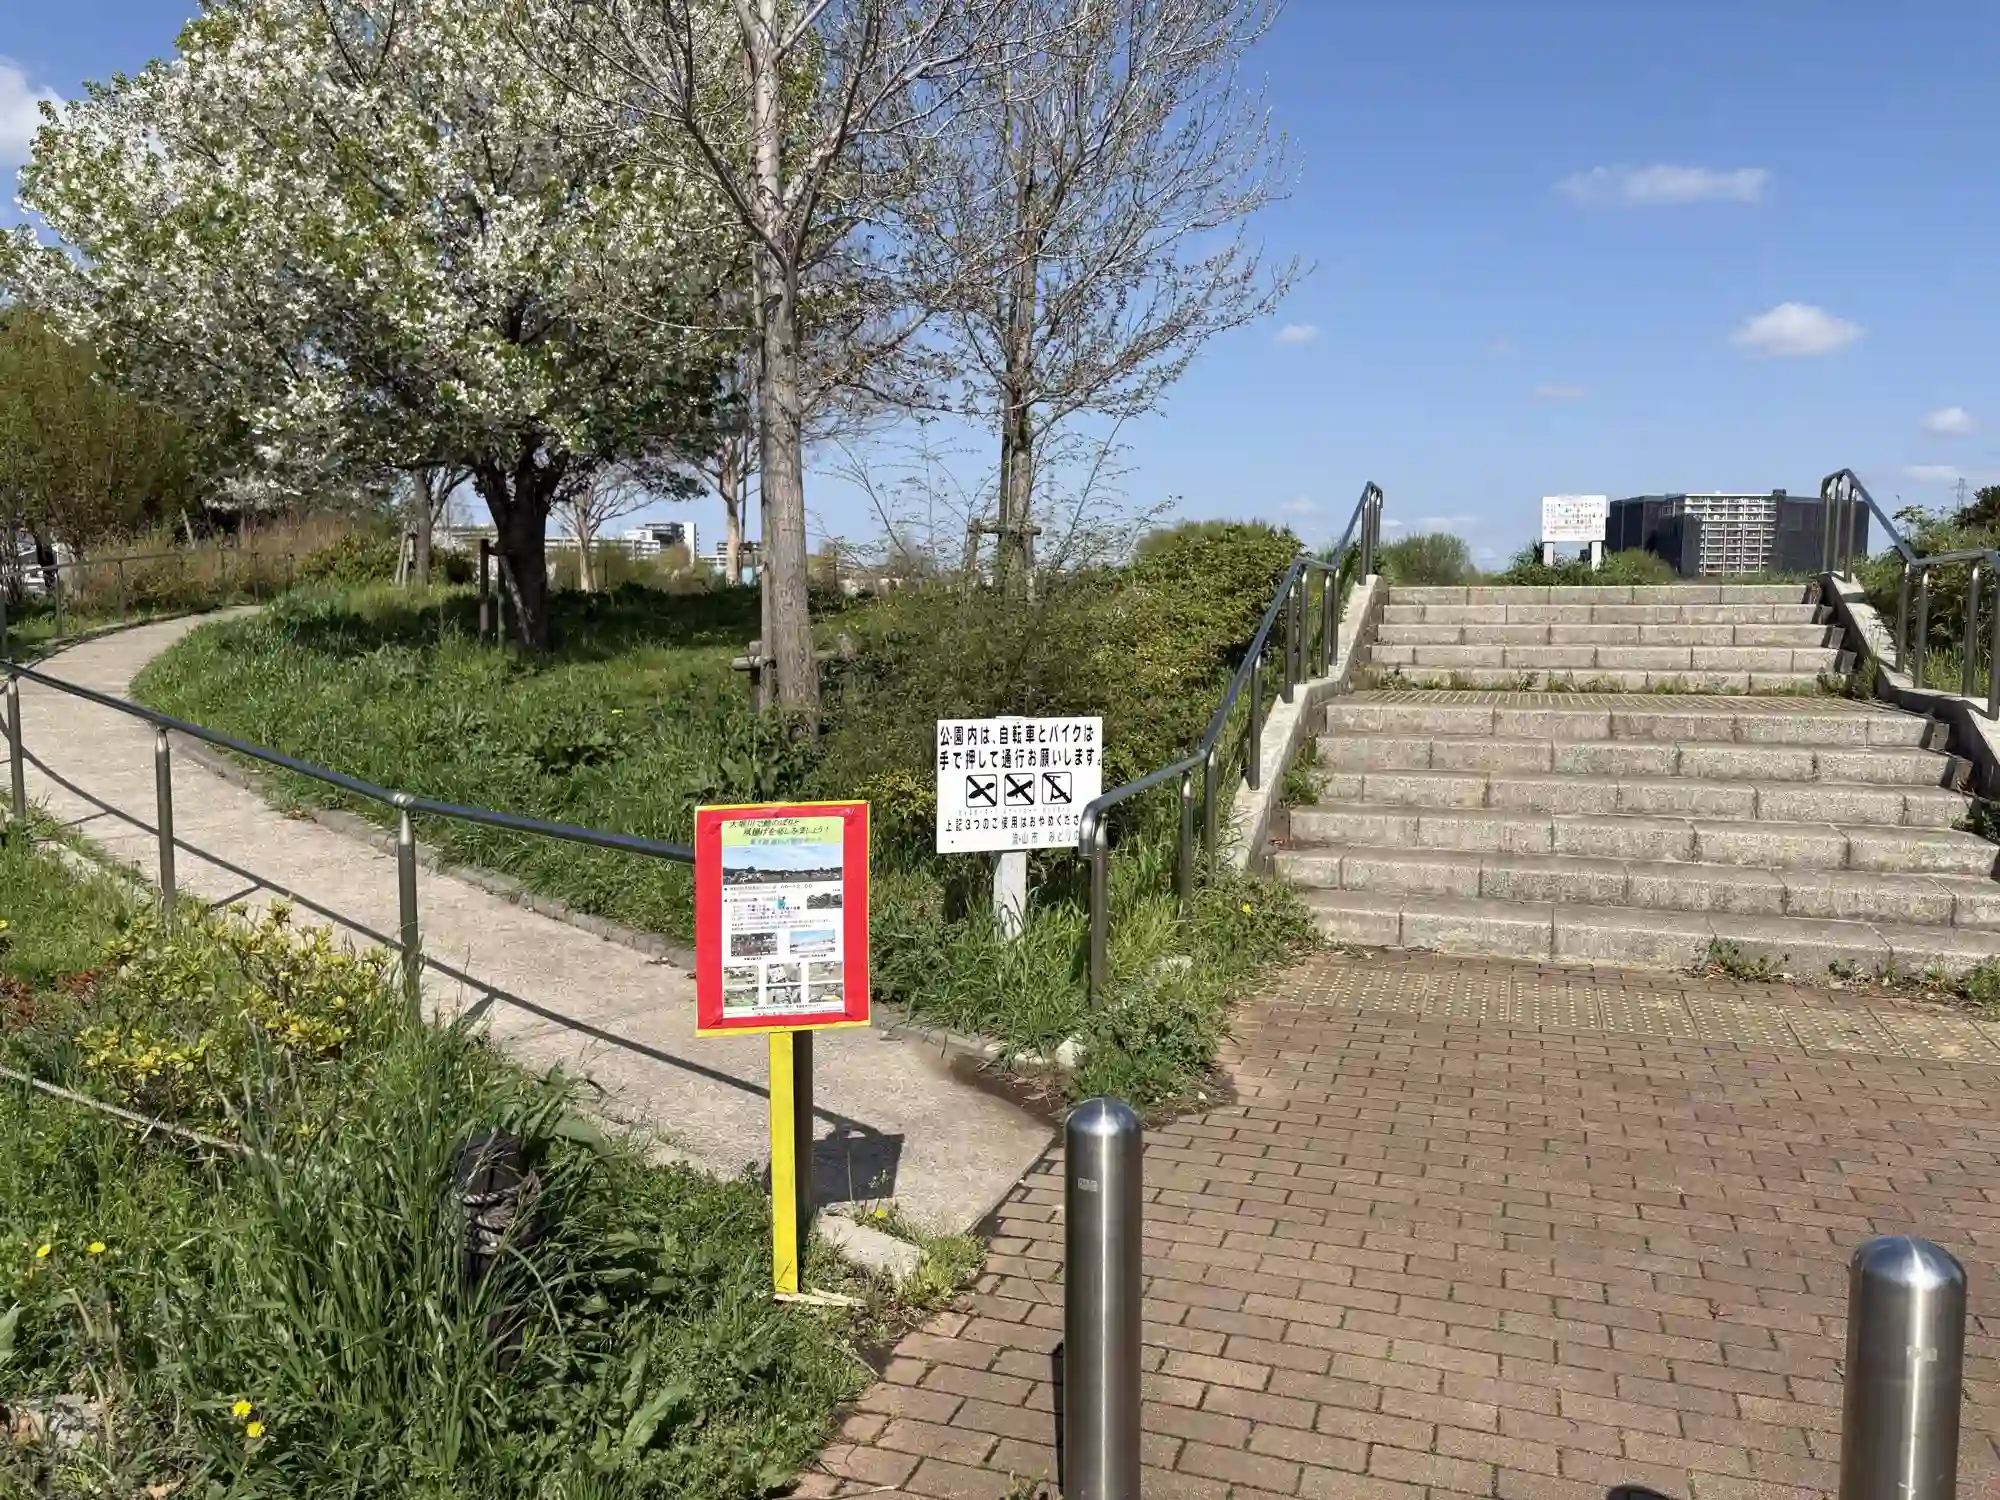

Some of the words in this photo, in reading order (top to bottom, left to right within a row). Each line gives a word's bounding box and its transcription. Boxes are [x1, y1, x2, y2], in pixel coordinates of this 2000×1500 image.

[940, 724, 1094, 746] 公園内は、自転車とバイクは
[940, 747, 1101, 770] 手で押して通行お願いします。
